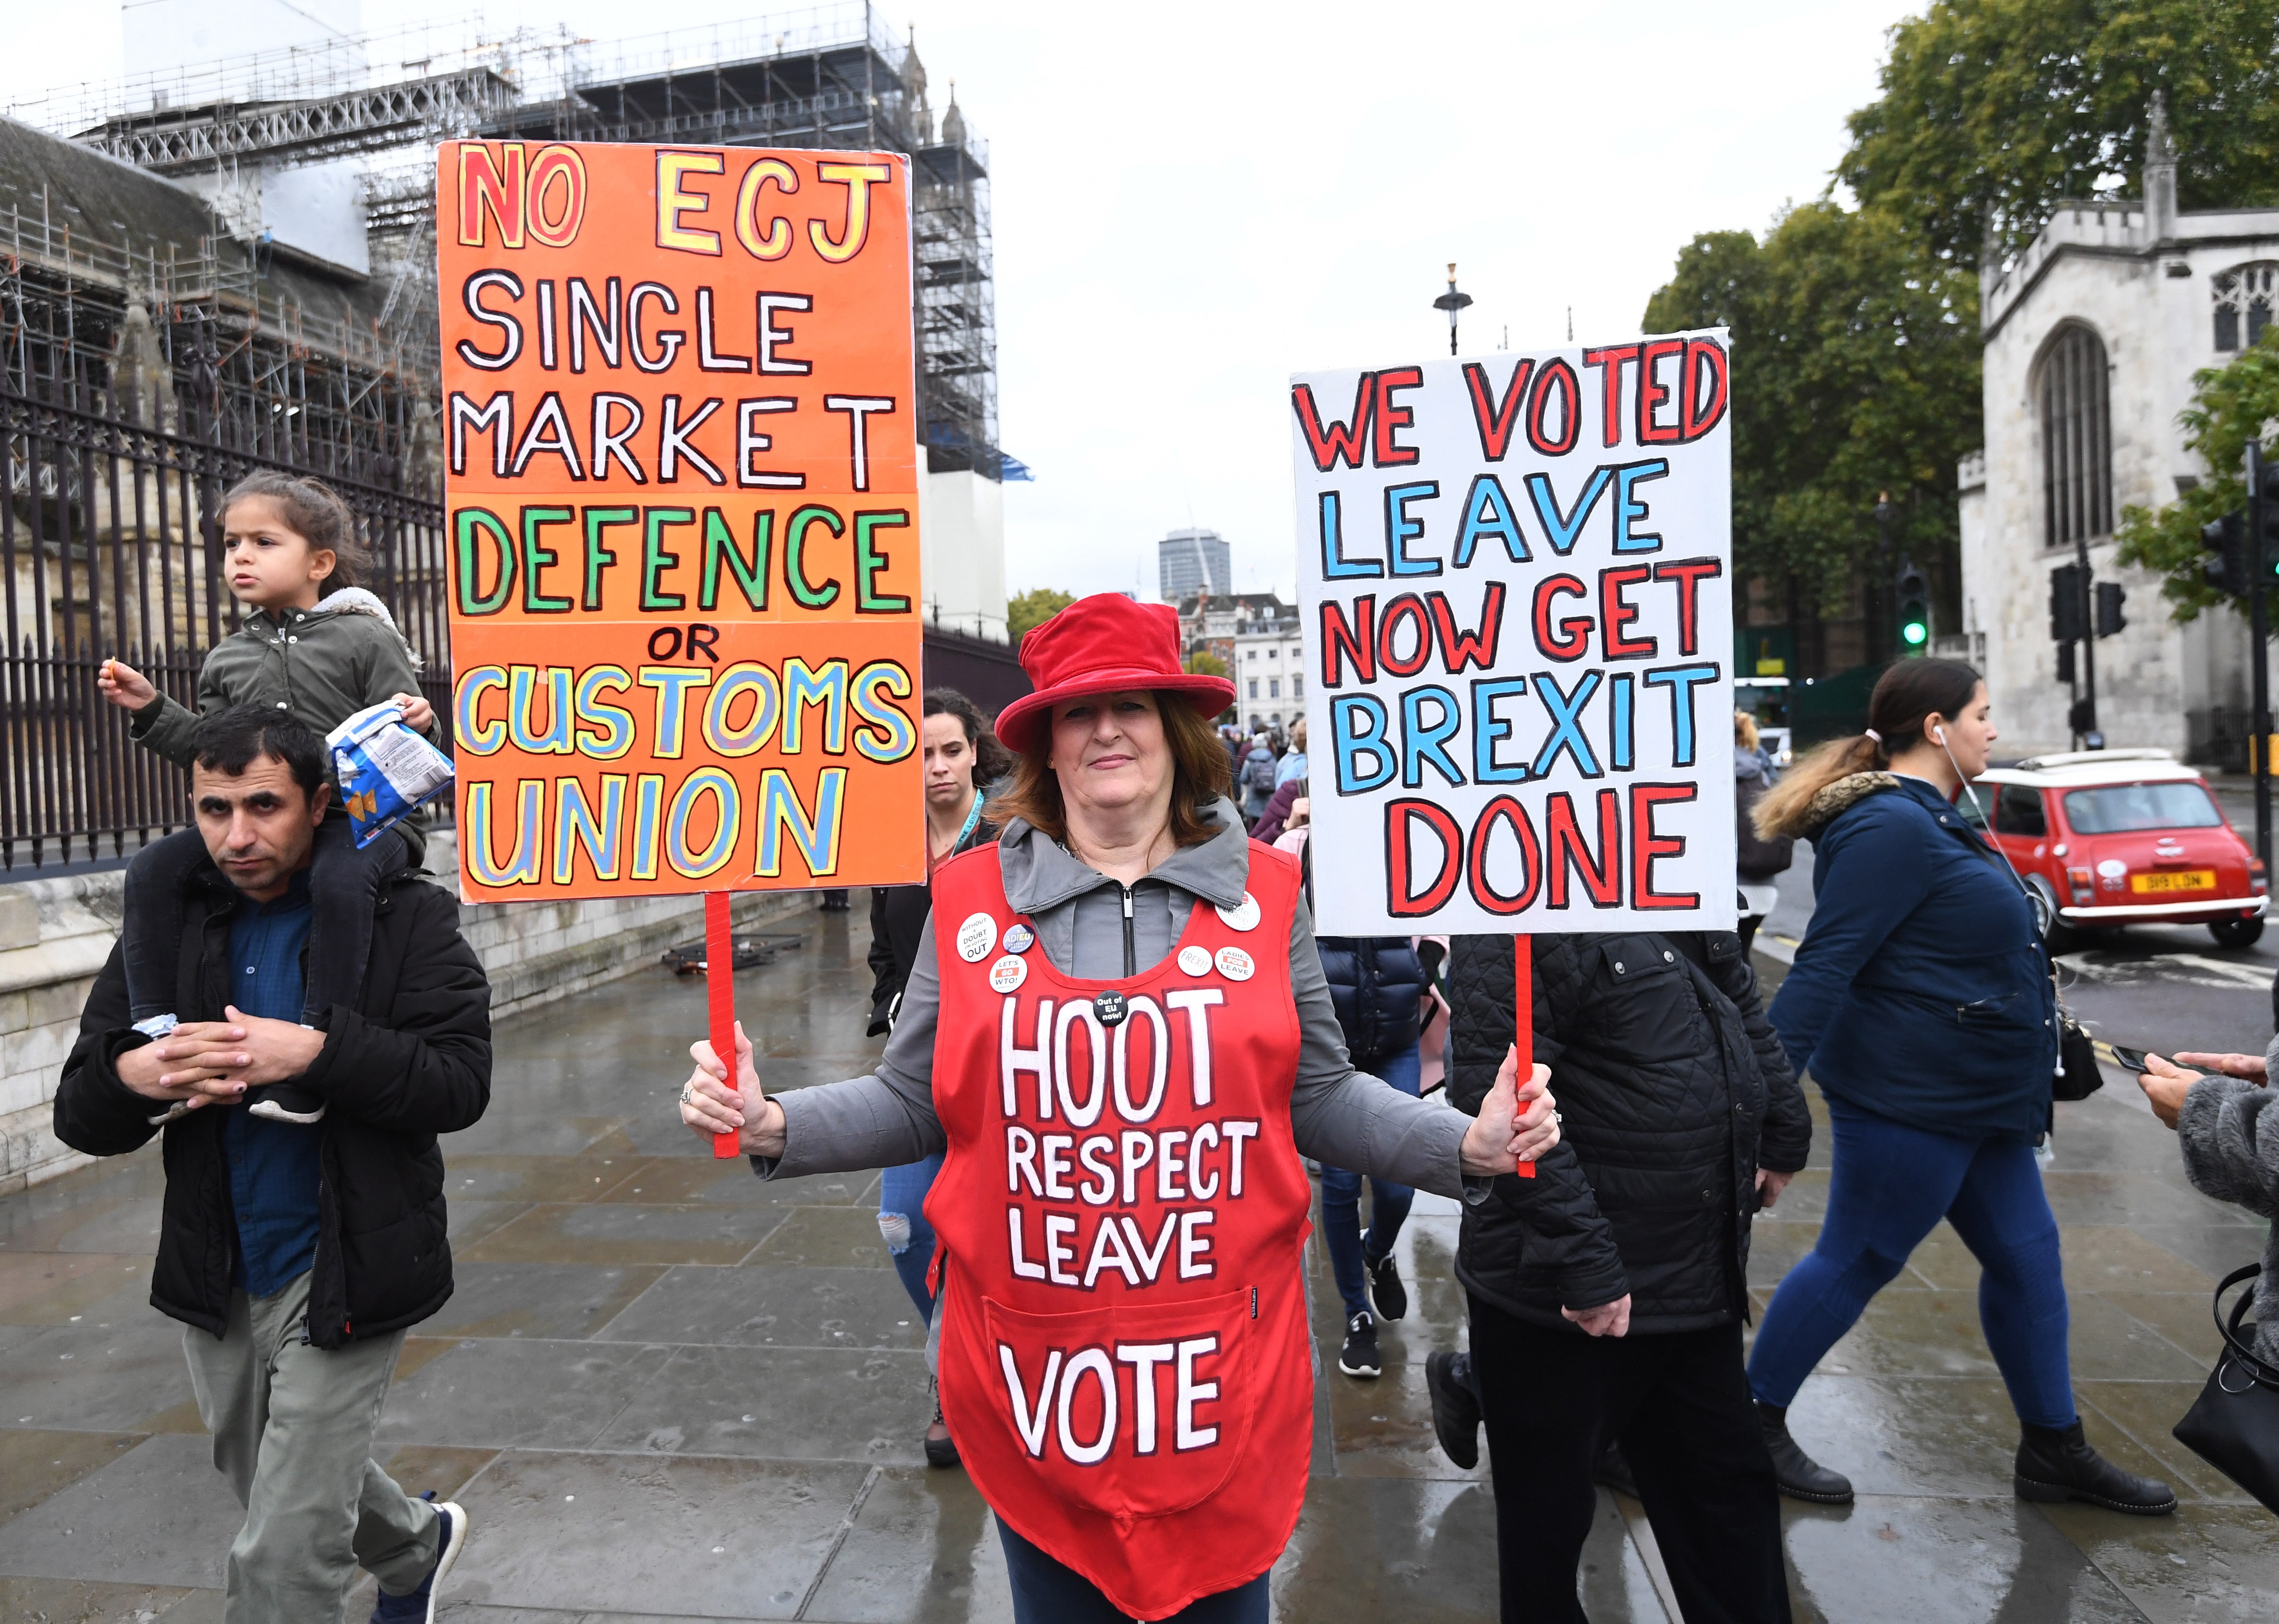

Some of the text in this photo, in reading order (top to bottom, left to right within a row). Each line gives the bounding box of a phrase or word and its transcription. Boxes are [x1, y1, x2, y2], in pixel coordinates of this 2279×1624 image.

[457, 143, 891, 264] NO ECJ
[455, 269, 813, 376] SINGLE
[449, 391, 895, 491] MARKET
[1291, 336, 1727, 472] WE VOTED
[453, 504, 912, 616] DEFENCE
[1320, 458, 1669, 581] LEAVE
[647, 623, 720, 663] OR
[1320, 557, 1722, 687] NOW GET
[454, 657, 916, 764] CUSTOMS
[1329, 662, 1720, 797] BREXIT
[466, 765, 850, 887] UNION
[958, 829, 969, 842] THE
[1384, 782, 1700, 918] DONE
[962, 918, 987, 932] WITHOUT
[964, 929, 987, 944] DOUBT
[967, 943, 987, 958] OUT
[972, 937, 987, 947] VOTING
[1180, 951, 1209, 969] FREXIT
[1221, 964, 1249, 975] LEAVE
[1222, 950, 1249, 960] LADIES
[1227, 957, 1244, 966] FOR
[997, 984, 1229, 1129] HOOT
[1102, 1012, 1122, 1020] now!
[1003, 1115, 1262, 1207] RESPECT
[1007, 1203, 1218, 1292] LEAVE
[996, 1330, 1221, 1467] VOTE
